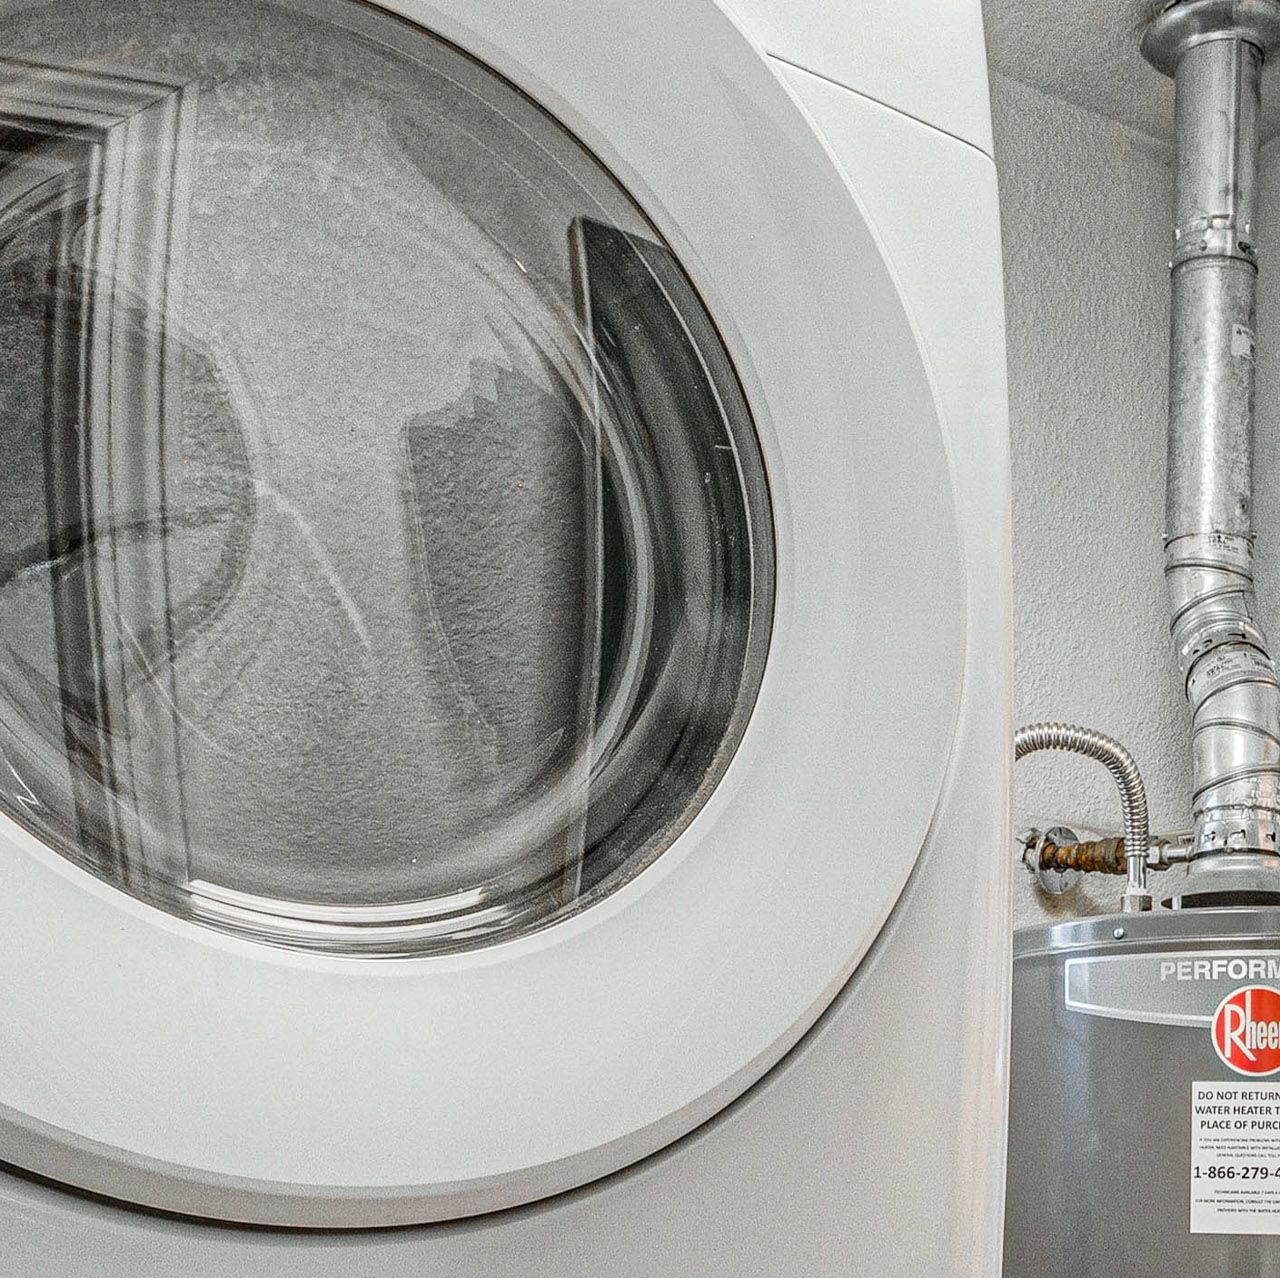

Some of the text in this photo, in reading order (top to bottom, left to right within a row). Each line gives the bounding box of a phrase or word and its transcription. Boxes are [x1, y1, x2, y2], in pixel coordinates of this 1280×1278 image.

[1198, 1091, 1213, 1100] DO
[1216, 1091, 1238, 1100] NOT
[1195, 1106, 1230, 1115] WATER
[1233, 1106, 1272, 1115] HEATER
[1200, 1120, 1231, 1129] PLACE
[1234, 1121, 1248, 1129] OF
